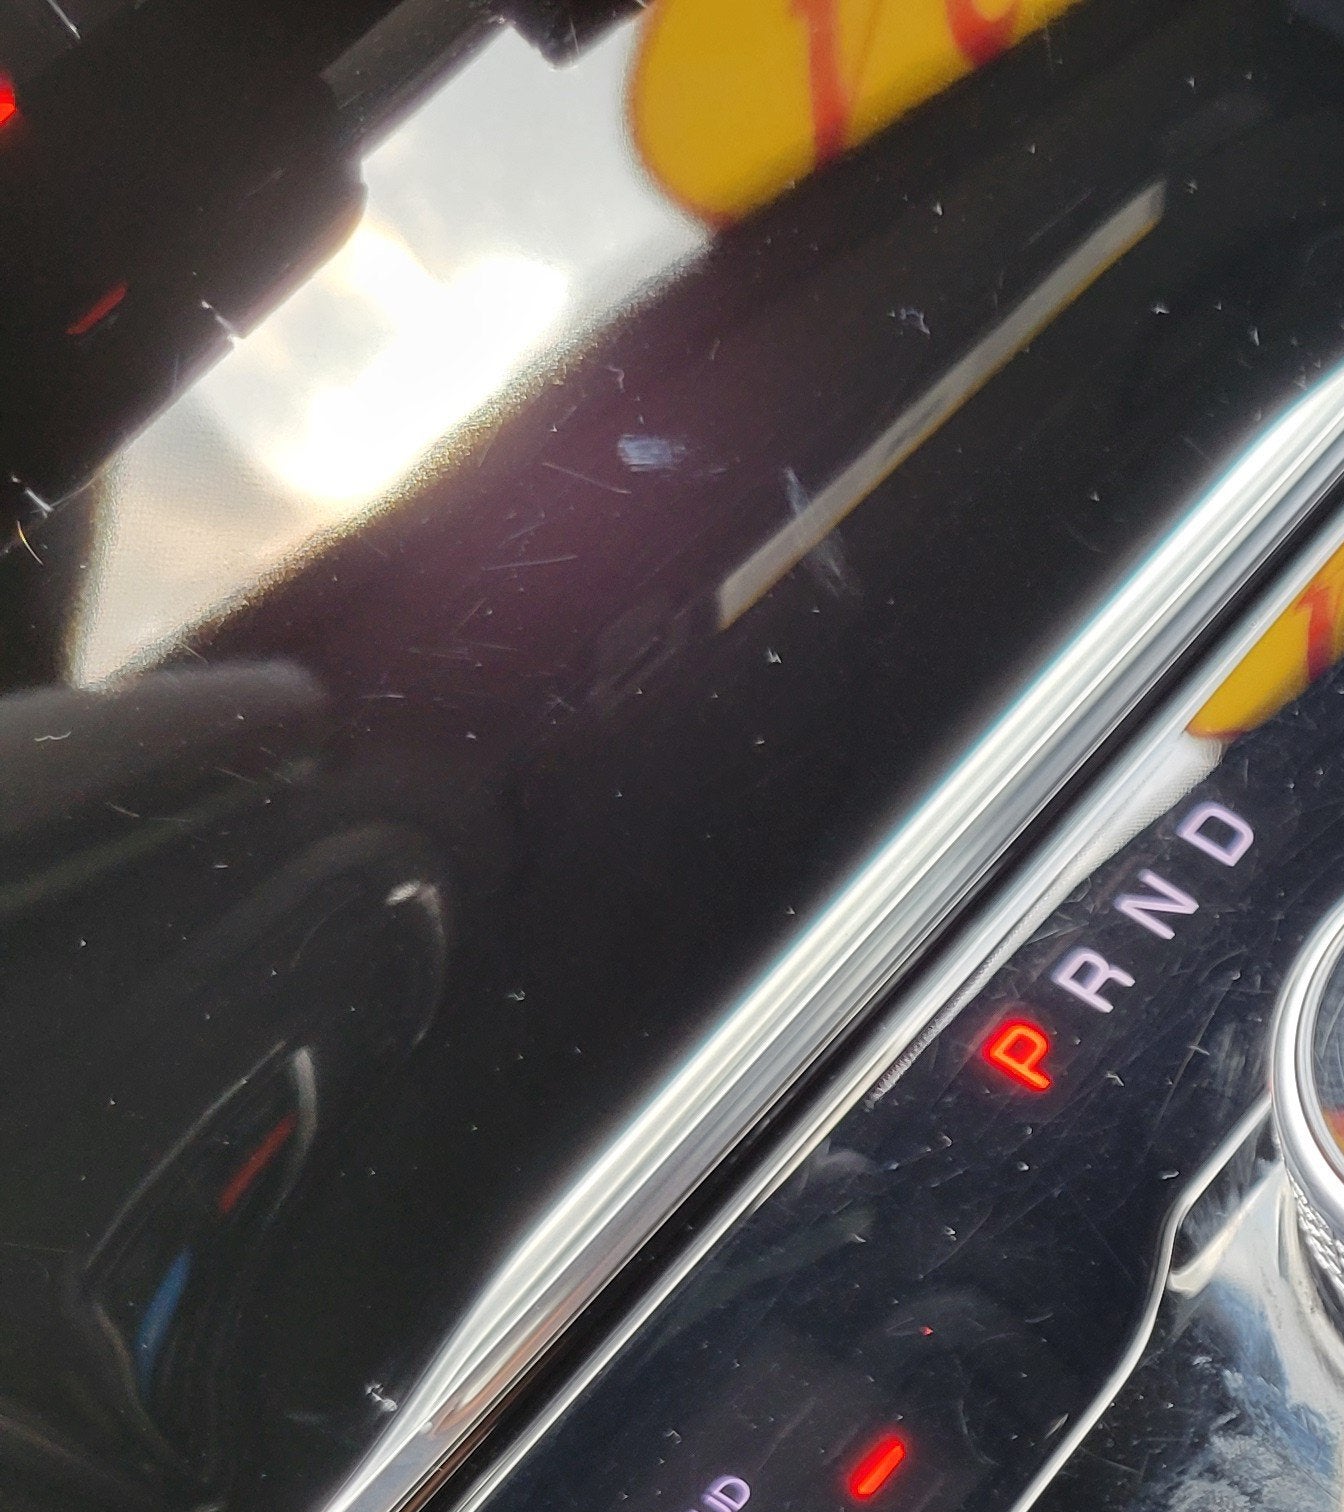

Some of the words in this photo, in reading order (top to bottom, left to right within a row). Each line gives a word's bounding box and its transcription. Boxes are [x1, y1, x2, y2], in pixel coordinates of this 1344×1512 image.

[985, 1019, 1051, 1092] P
[1051, 947, 1136, 1013] R
[1115, 869, 1199, 939] N
[1176, 801, 1254, 867] D
